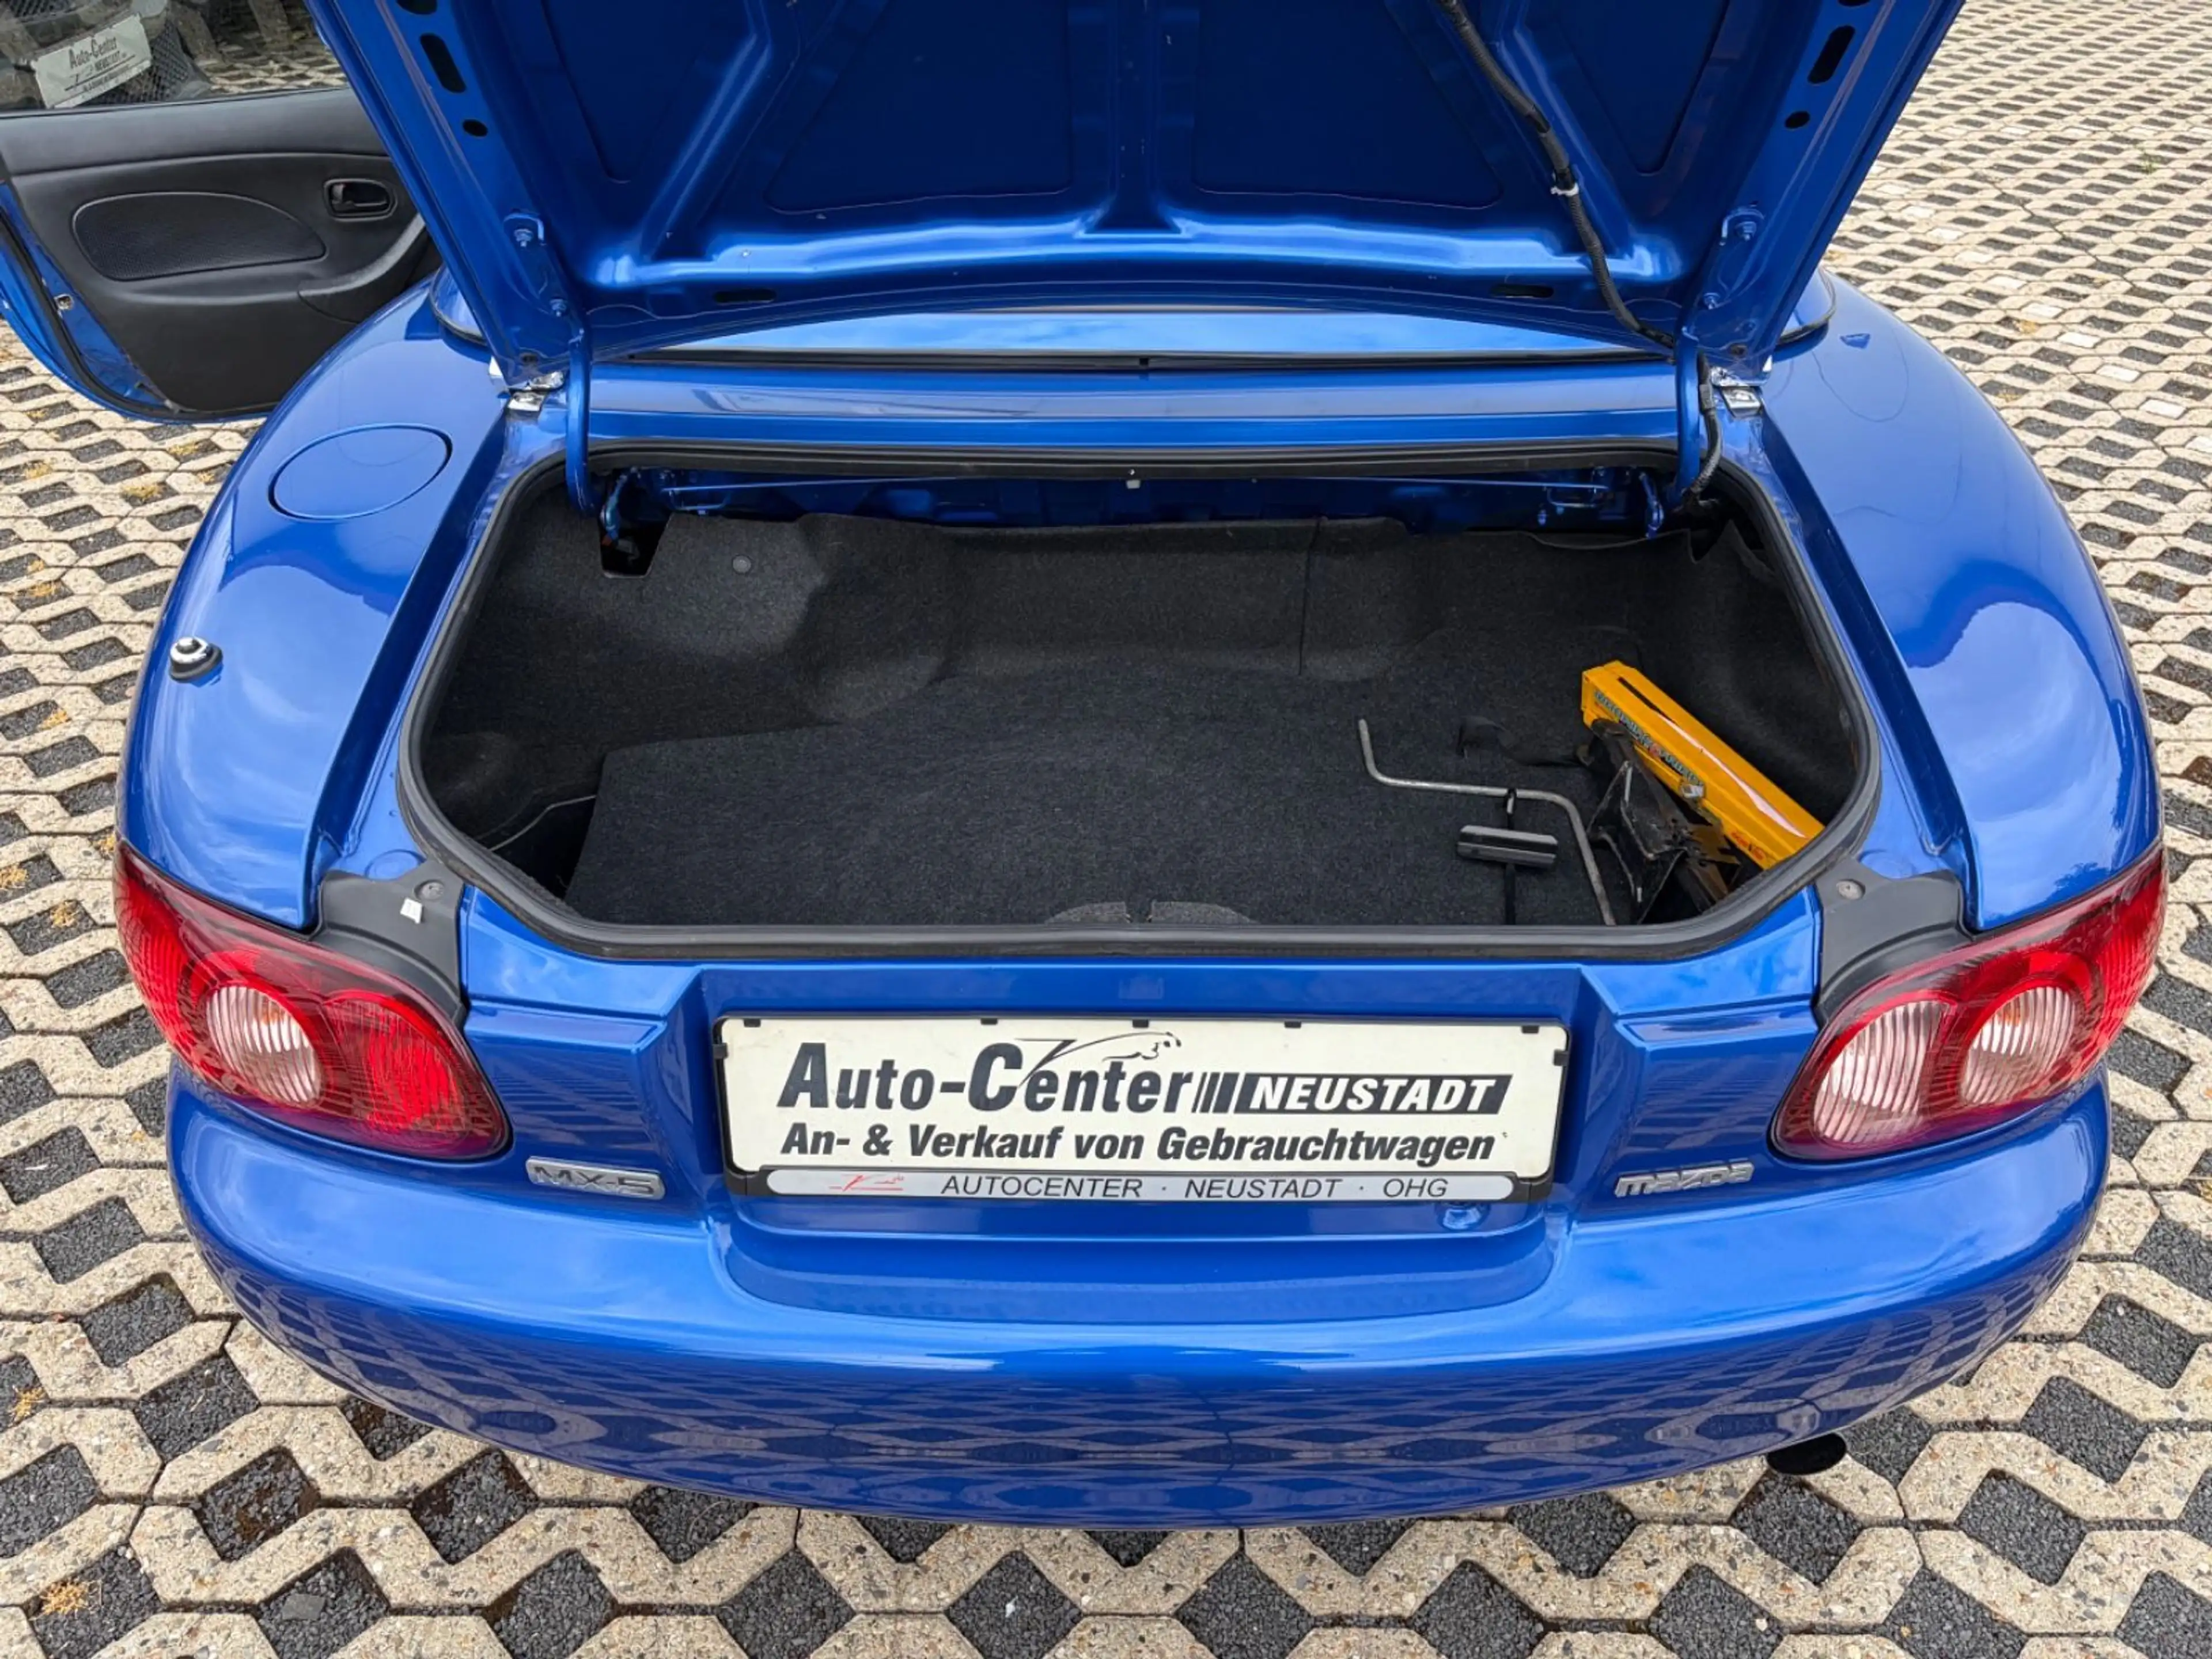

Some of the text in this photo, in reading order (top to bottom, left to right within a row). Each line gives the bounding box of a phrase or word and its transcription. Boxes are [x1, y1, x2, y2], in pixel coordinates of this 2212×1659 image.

[777, 1041, 1497, 1113] Auto-Center NEUSTADT
[781, 1122, 1495, 1168] An- & Verkauf von Gebrauchtwagen
[533, 1166, 655, 1195] MX-5
[941, 1175, 1449, 1199] AUTOCENTER NEUSTADT OHG
